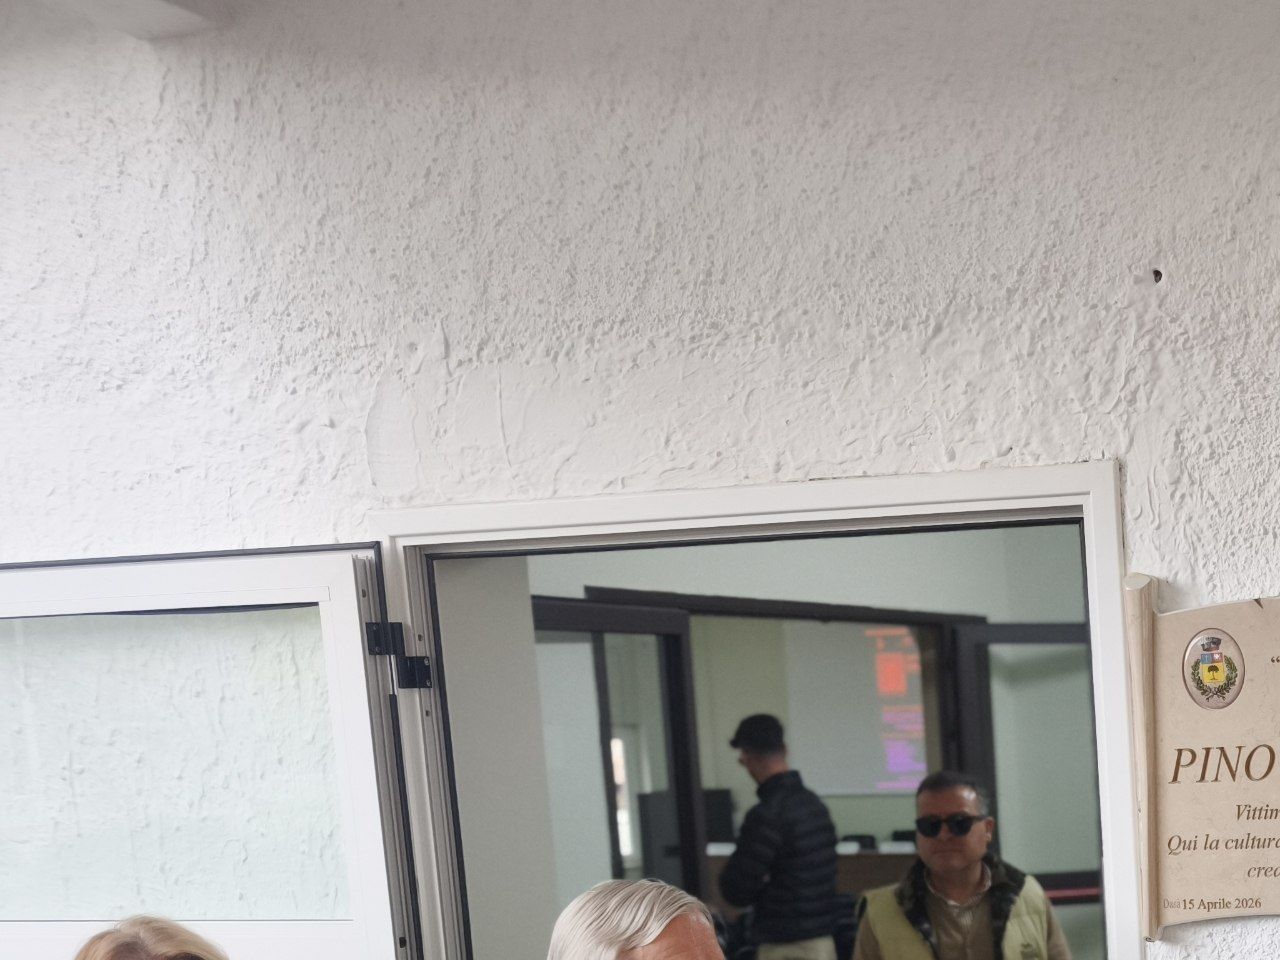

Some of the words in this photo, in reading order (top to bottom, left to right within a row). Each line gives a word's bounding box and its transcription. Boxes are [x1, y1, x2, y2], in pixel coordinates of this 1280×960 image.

[1168, 743, 1276, 784] PINO
[1167, 834, 1198, 856] Qui
[1203, 833, 1220, 851] la
[1182, 898, 1196, 910] 15
[1197, 898, 1232, 912] Aprile
[1234, 897, 1262, 909] 2026
